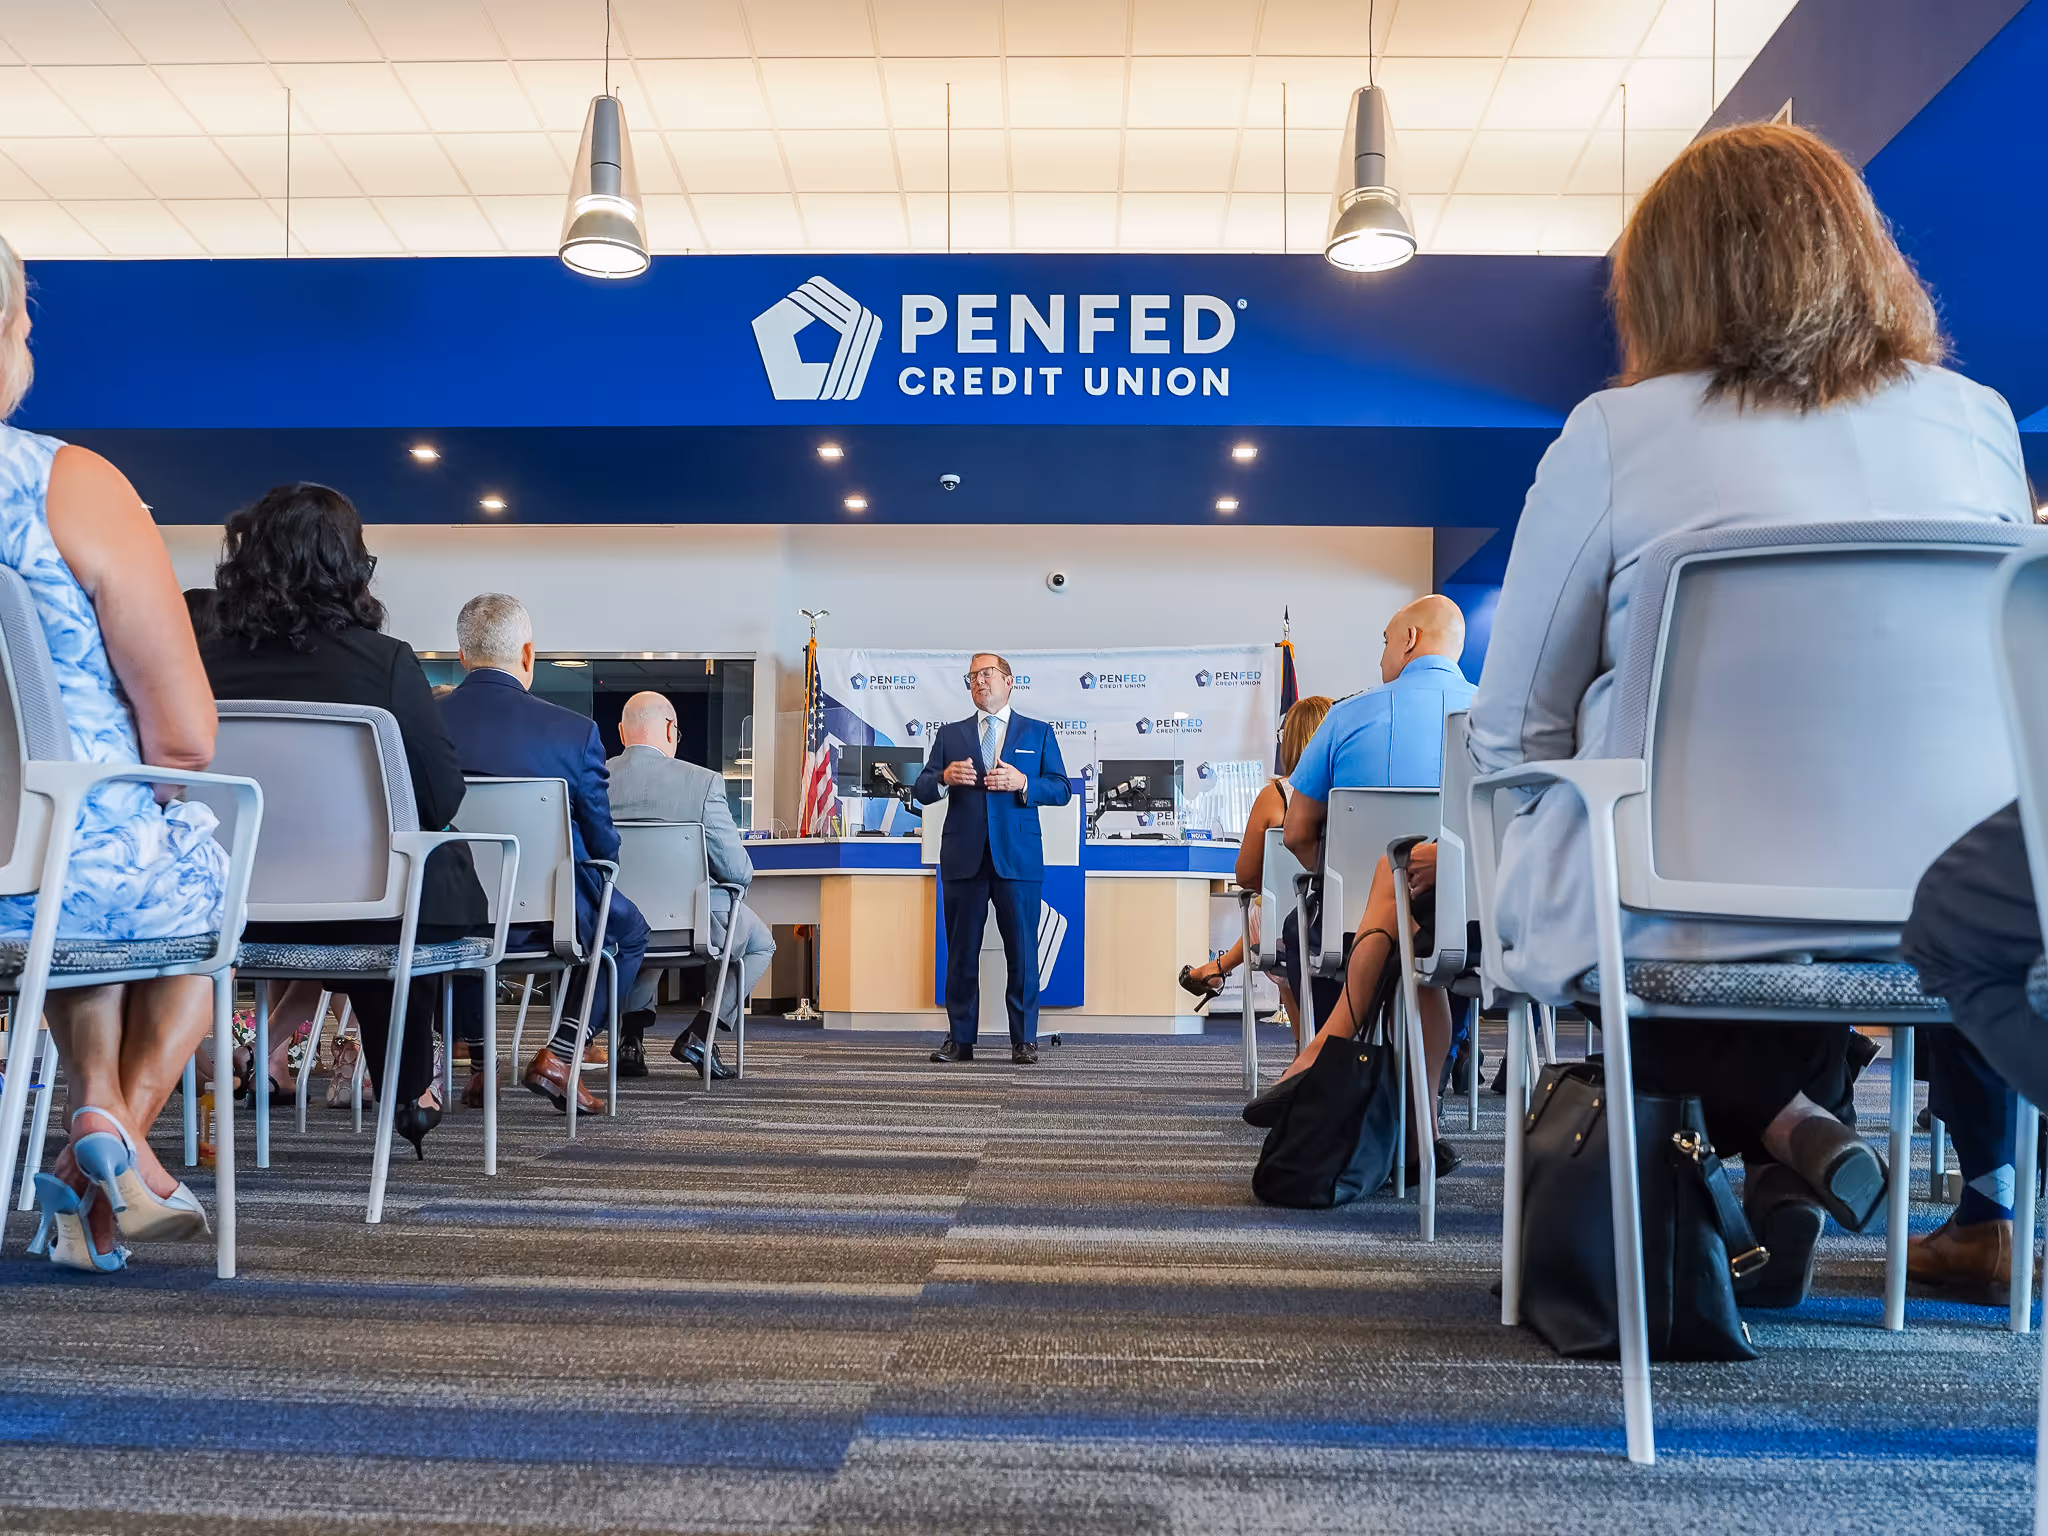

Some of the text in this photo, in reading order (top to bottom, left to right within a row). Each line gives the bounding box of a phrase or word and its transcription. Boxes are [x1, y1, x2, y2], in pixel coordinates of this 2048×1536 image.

[899, 367, 1230, 396] CREDIT UNION
[870, 675, 916, 684] PENFED
[1100, 674, 1146, 683] PENFED
[1215, 671, 1261, 680] PENFED
[1156, 719, 1203, 728] PENFED
